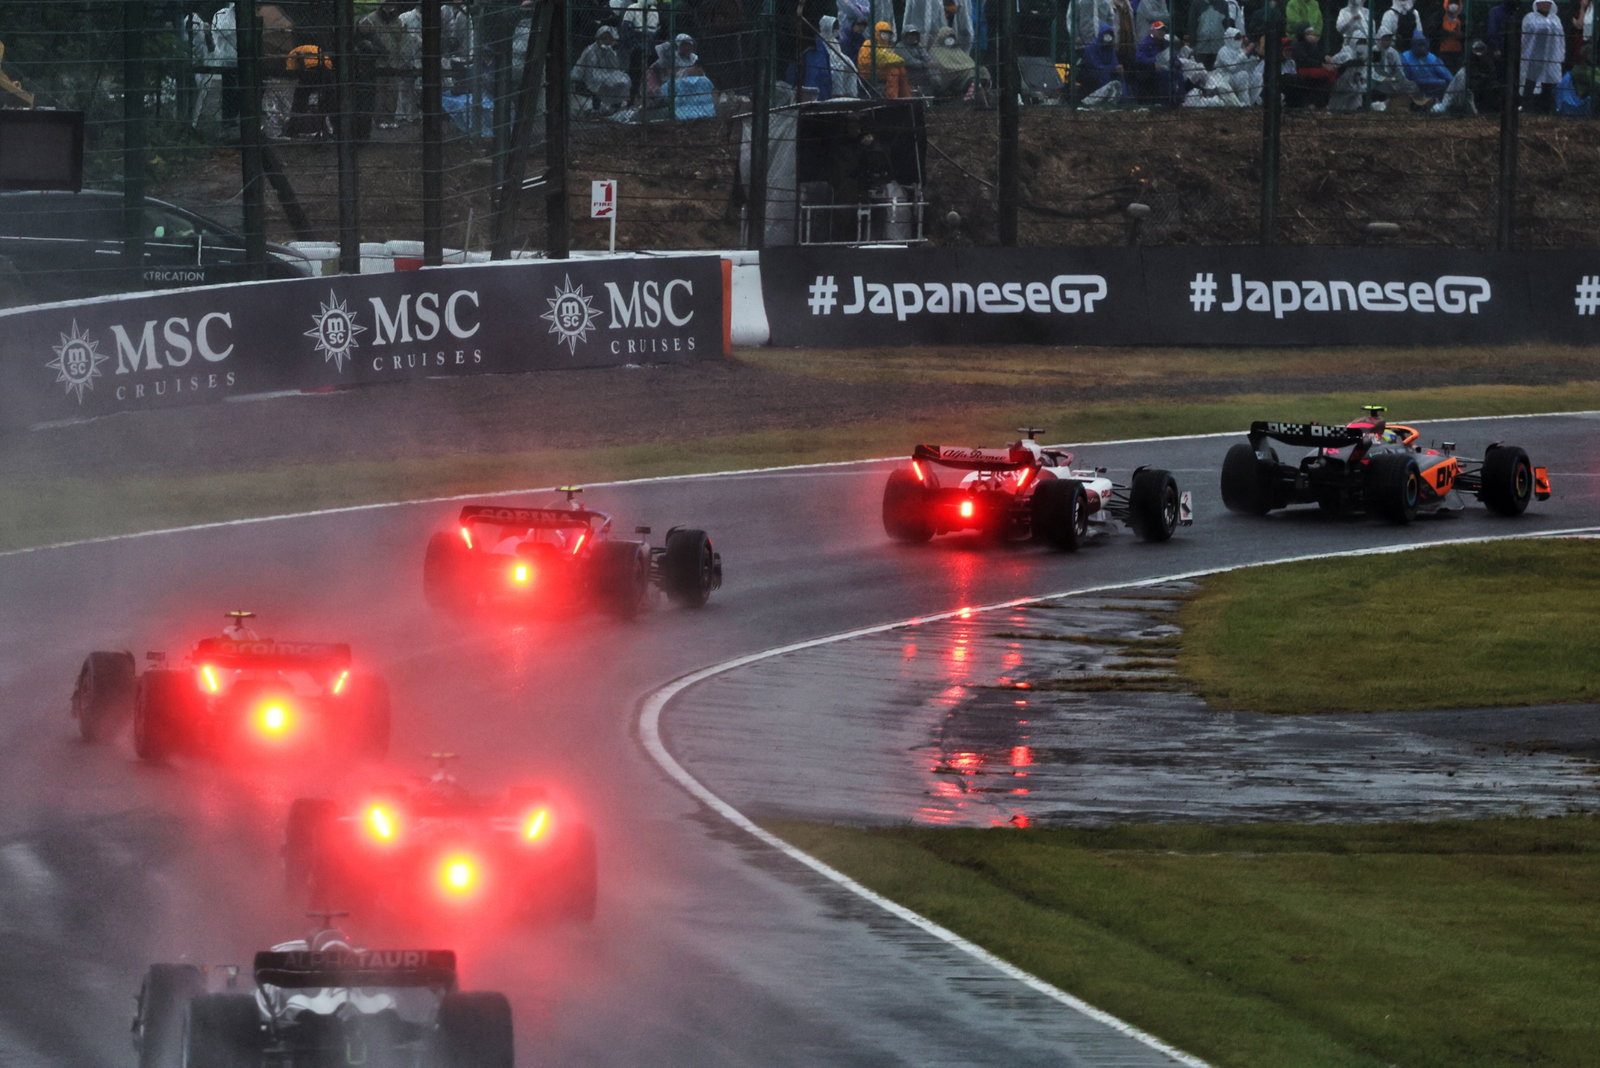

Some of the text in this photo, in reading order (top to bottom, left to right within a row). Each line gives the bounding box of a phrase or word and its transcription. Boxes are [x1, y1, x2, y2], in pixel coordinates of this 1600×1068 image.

[368, 289, 481, 346] MSC
[603, 278, 695, 330] MSC
[807, 274, 1108, 322] #JapaneseGP
[1189, 272, 1491, 319] #JapaneseGP
[110, 311, 235, 375] MSC
[372, 348, 483, 371] CRUISES
[610, 336, 697, 354] CRUISES
[115, 371, 237, 401] CRUISES
[942, 448, 968, 459] Alfa
